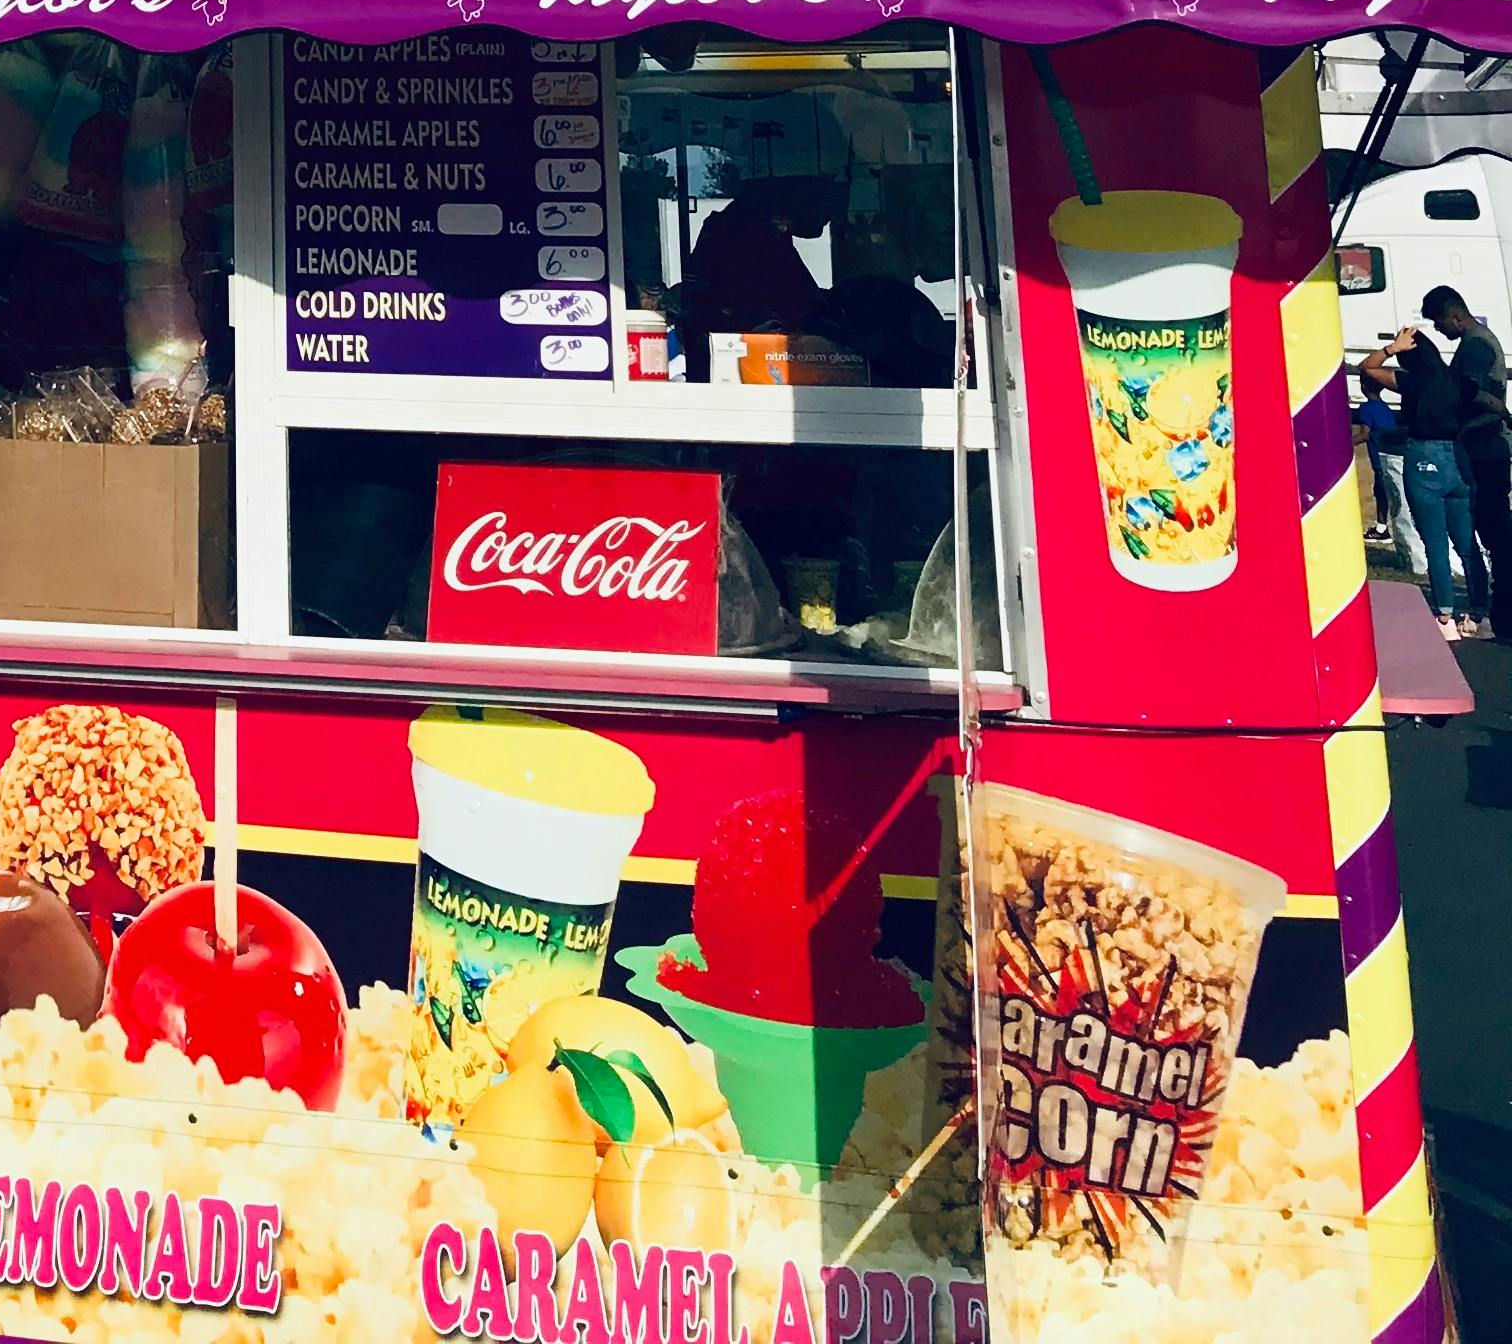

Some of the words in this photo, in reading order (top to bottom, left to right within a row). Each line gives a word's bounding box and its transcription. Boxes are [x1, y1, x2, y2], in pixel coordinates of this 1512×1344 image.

[374, 36, 451, 62] APPLES
[294, 77, 368, 104] CANDY
[375, 77, 391, 104] &
[397, 77, 514, 105] SPRINKLES
[294, 119, 396, 147] CARAMEL
[401, 119, 481, 148] APPLES
[294, 162, 397, 190] CARAMEL
[404, 163, 420, 190] &
[426, 162, 487, 191] NUTS
[295, 204, 402, 233] POPCORN
[411, 220, 435, 234] SM.
[509, 221, 531, 235] LG.
[295, 247, 418, 277] LEMONADE
[295, 291, 356, 320] COLD
[363, 292, 447, 321] DRINKS
[295, 333, 370, 363] WATER
[1086, 322, 1186, 350] LEMONADE
[765, 350, 794, 361] nitrile
[797, 353, 827, 362] exam
[443, 511, 708, 602] Coca-Cola
[427, 875, 550, 942] LEMONADE
[1000, 993, 1208, 1110] aramel
[419, 1220, 749, 1344] CARAMEL
[767, 1258, 988, 1344] APPLE
